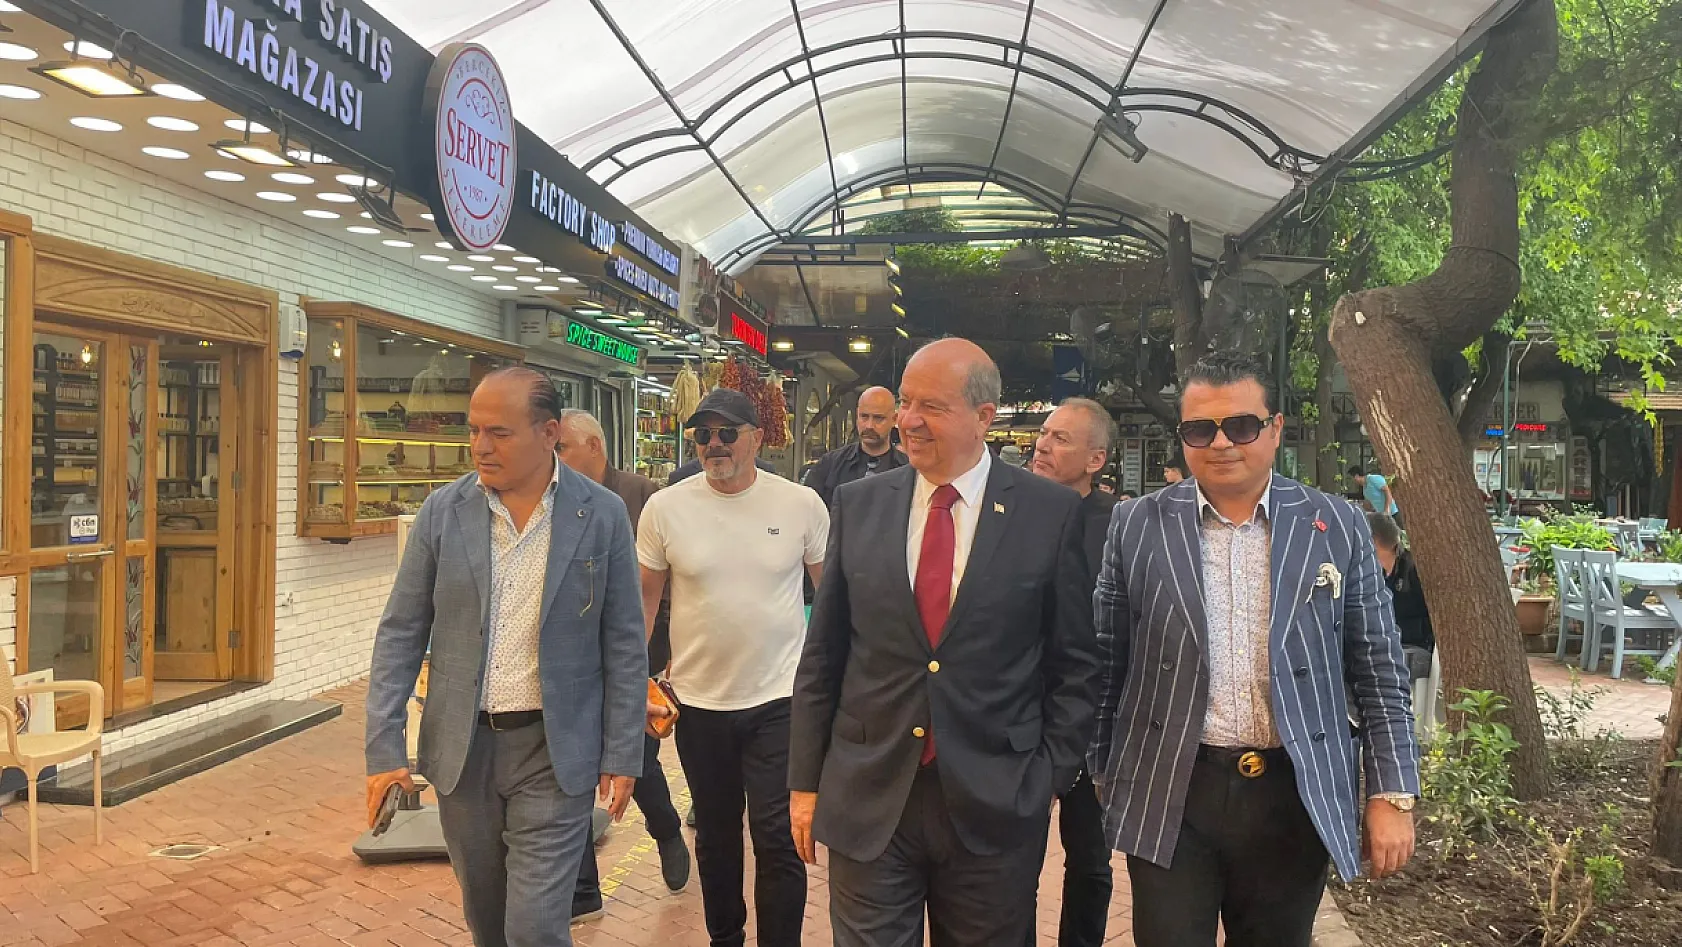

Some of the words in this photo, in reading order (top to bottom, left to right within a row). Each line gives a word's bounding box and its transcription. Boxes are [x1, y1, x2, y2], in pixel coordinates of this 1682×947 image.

[204, 0, 363, 132] MAĞAZASI
[319, 0, 393, 84] SATIŞ
[444, 107, 510, 188] SERVET
[531, 169, 587, 237] FACTORY
[590, 211, 616, 255] SHOP
[567, 322, 592, 349] SPICE
